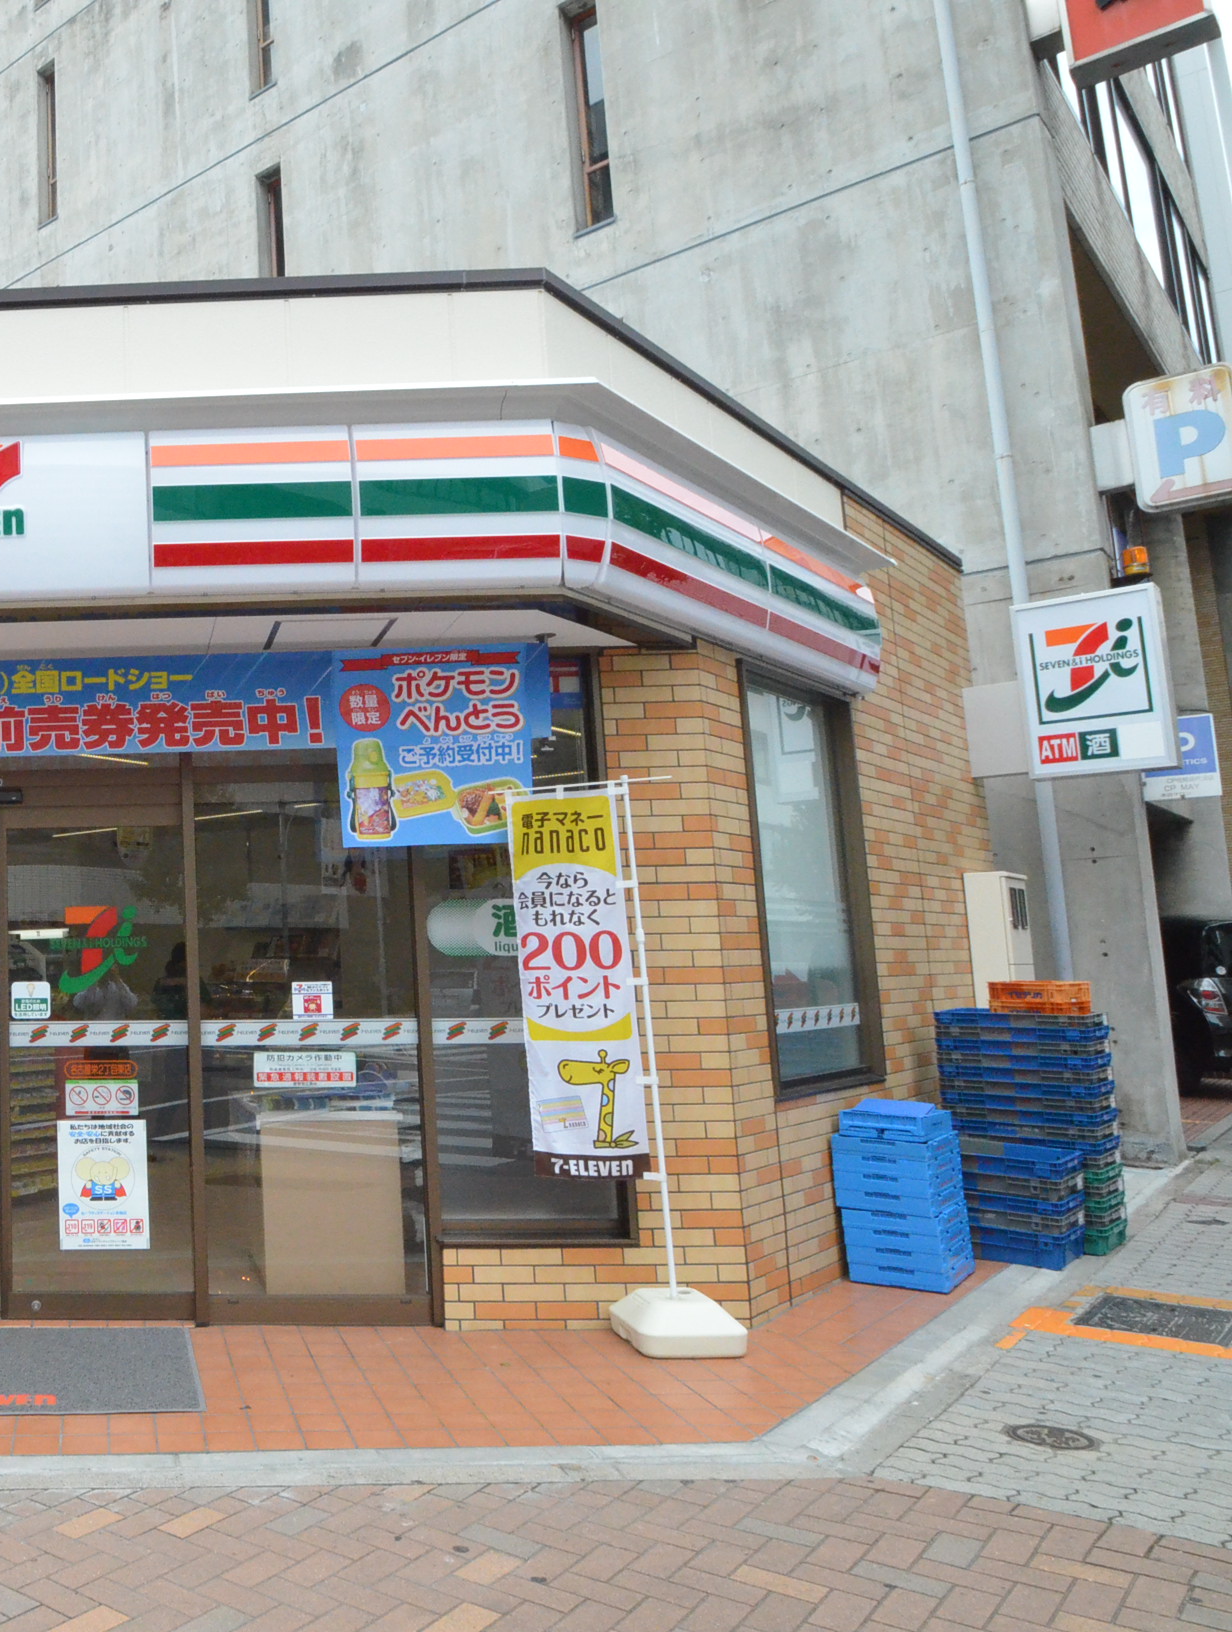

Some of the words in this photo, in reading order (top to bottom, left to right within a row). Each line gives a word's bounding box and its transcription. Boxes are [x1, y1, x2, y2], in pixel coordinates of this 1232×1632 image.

[1141, 375, 1221, 416] 有料
[1153, 409, 1226, 479] P
[1085, 648, 1140, 665] HOLDINGS
[394, 669, 516, 700] ポケモン
[349, 694, 379, 708] 数量
[352, 711, 381, 725] 限定
[399, 702, 521, 733] べんとう
[401, 742, 521, 765] ご予約受付中!
[1040, 737, 1077, 760] ATM
[1086, 733, 1111, 756] 酒
[521, 810, 604, 830] 電子マネー
[521, 827, 606, 856] nanaco
[536, 871, 589, 890] 今なら
[518, 888, 617, 910] 会員になると
[532, 908, 601, 927] もれなく
[95, 935, 147, 948] HOLDINGS
[521, 929, 623, 971] 200
[527, 974, 621, 1000] ポイント
[15, 1003, 47, 1011] LED照明
[536, 1002, 616, 1019] プレゼント
[267, 1053, 343, 1062] 防犯カメラ作動中
[94, 1185, 112, 1194] SS
